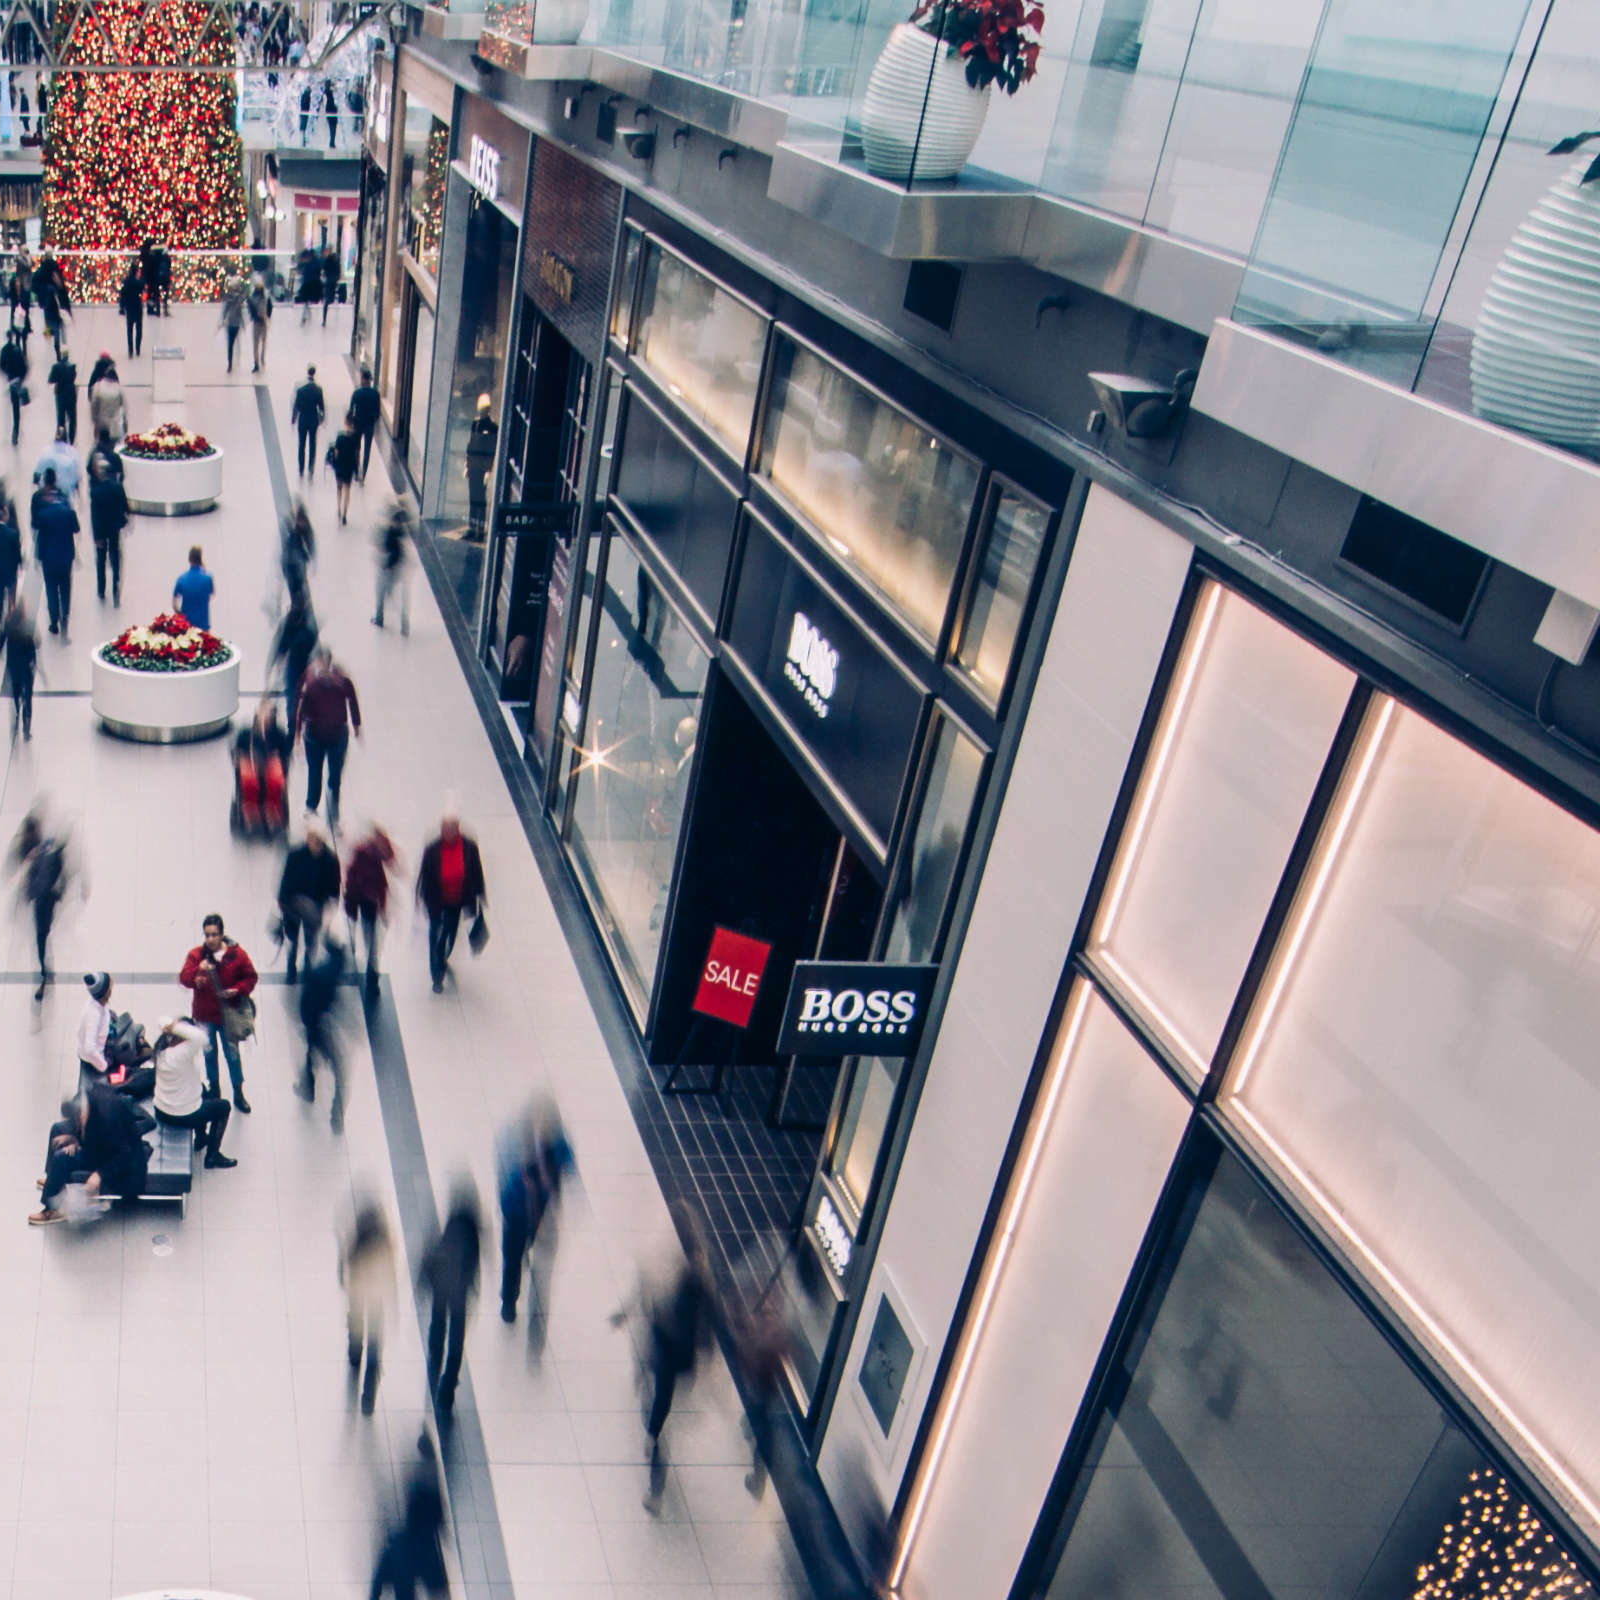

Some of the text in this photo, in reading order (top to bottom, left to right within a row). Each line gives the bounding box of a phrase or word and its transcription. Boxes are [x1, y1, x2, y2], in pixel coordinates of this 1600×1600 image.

[470, 134, 500, 200] REISS
[787, 612, 839, 699] BOSS
[704, 960, 759, 996] SALE
[800, 988, 916, 1023] BOSS
[797, 1022, 909, 1034] HUGO BOSS
